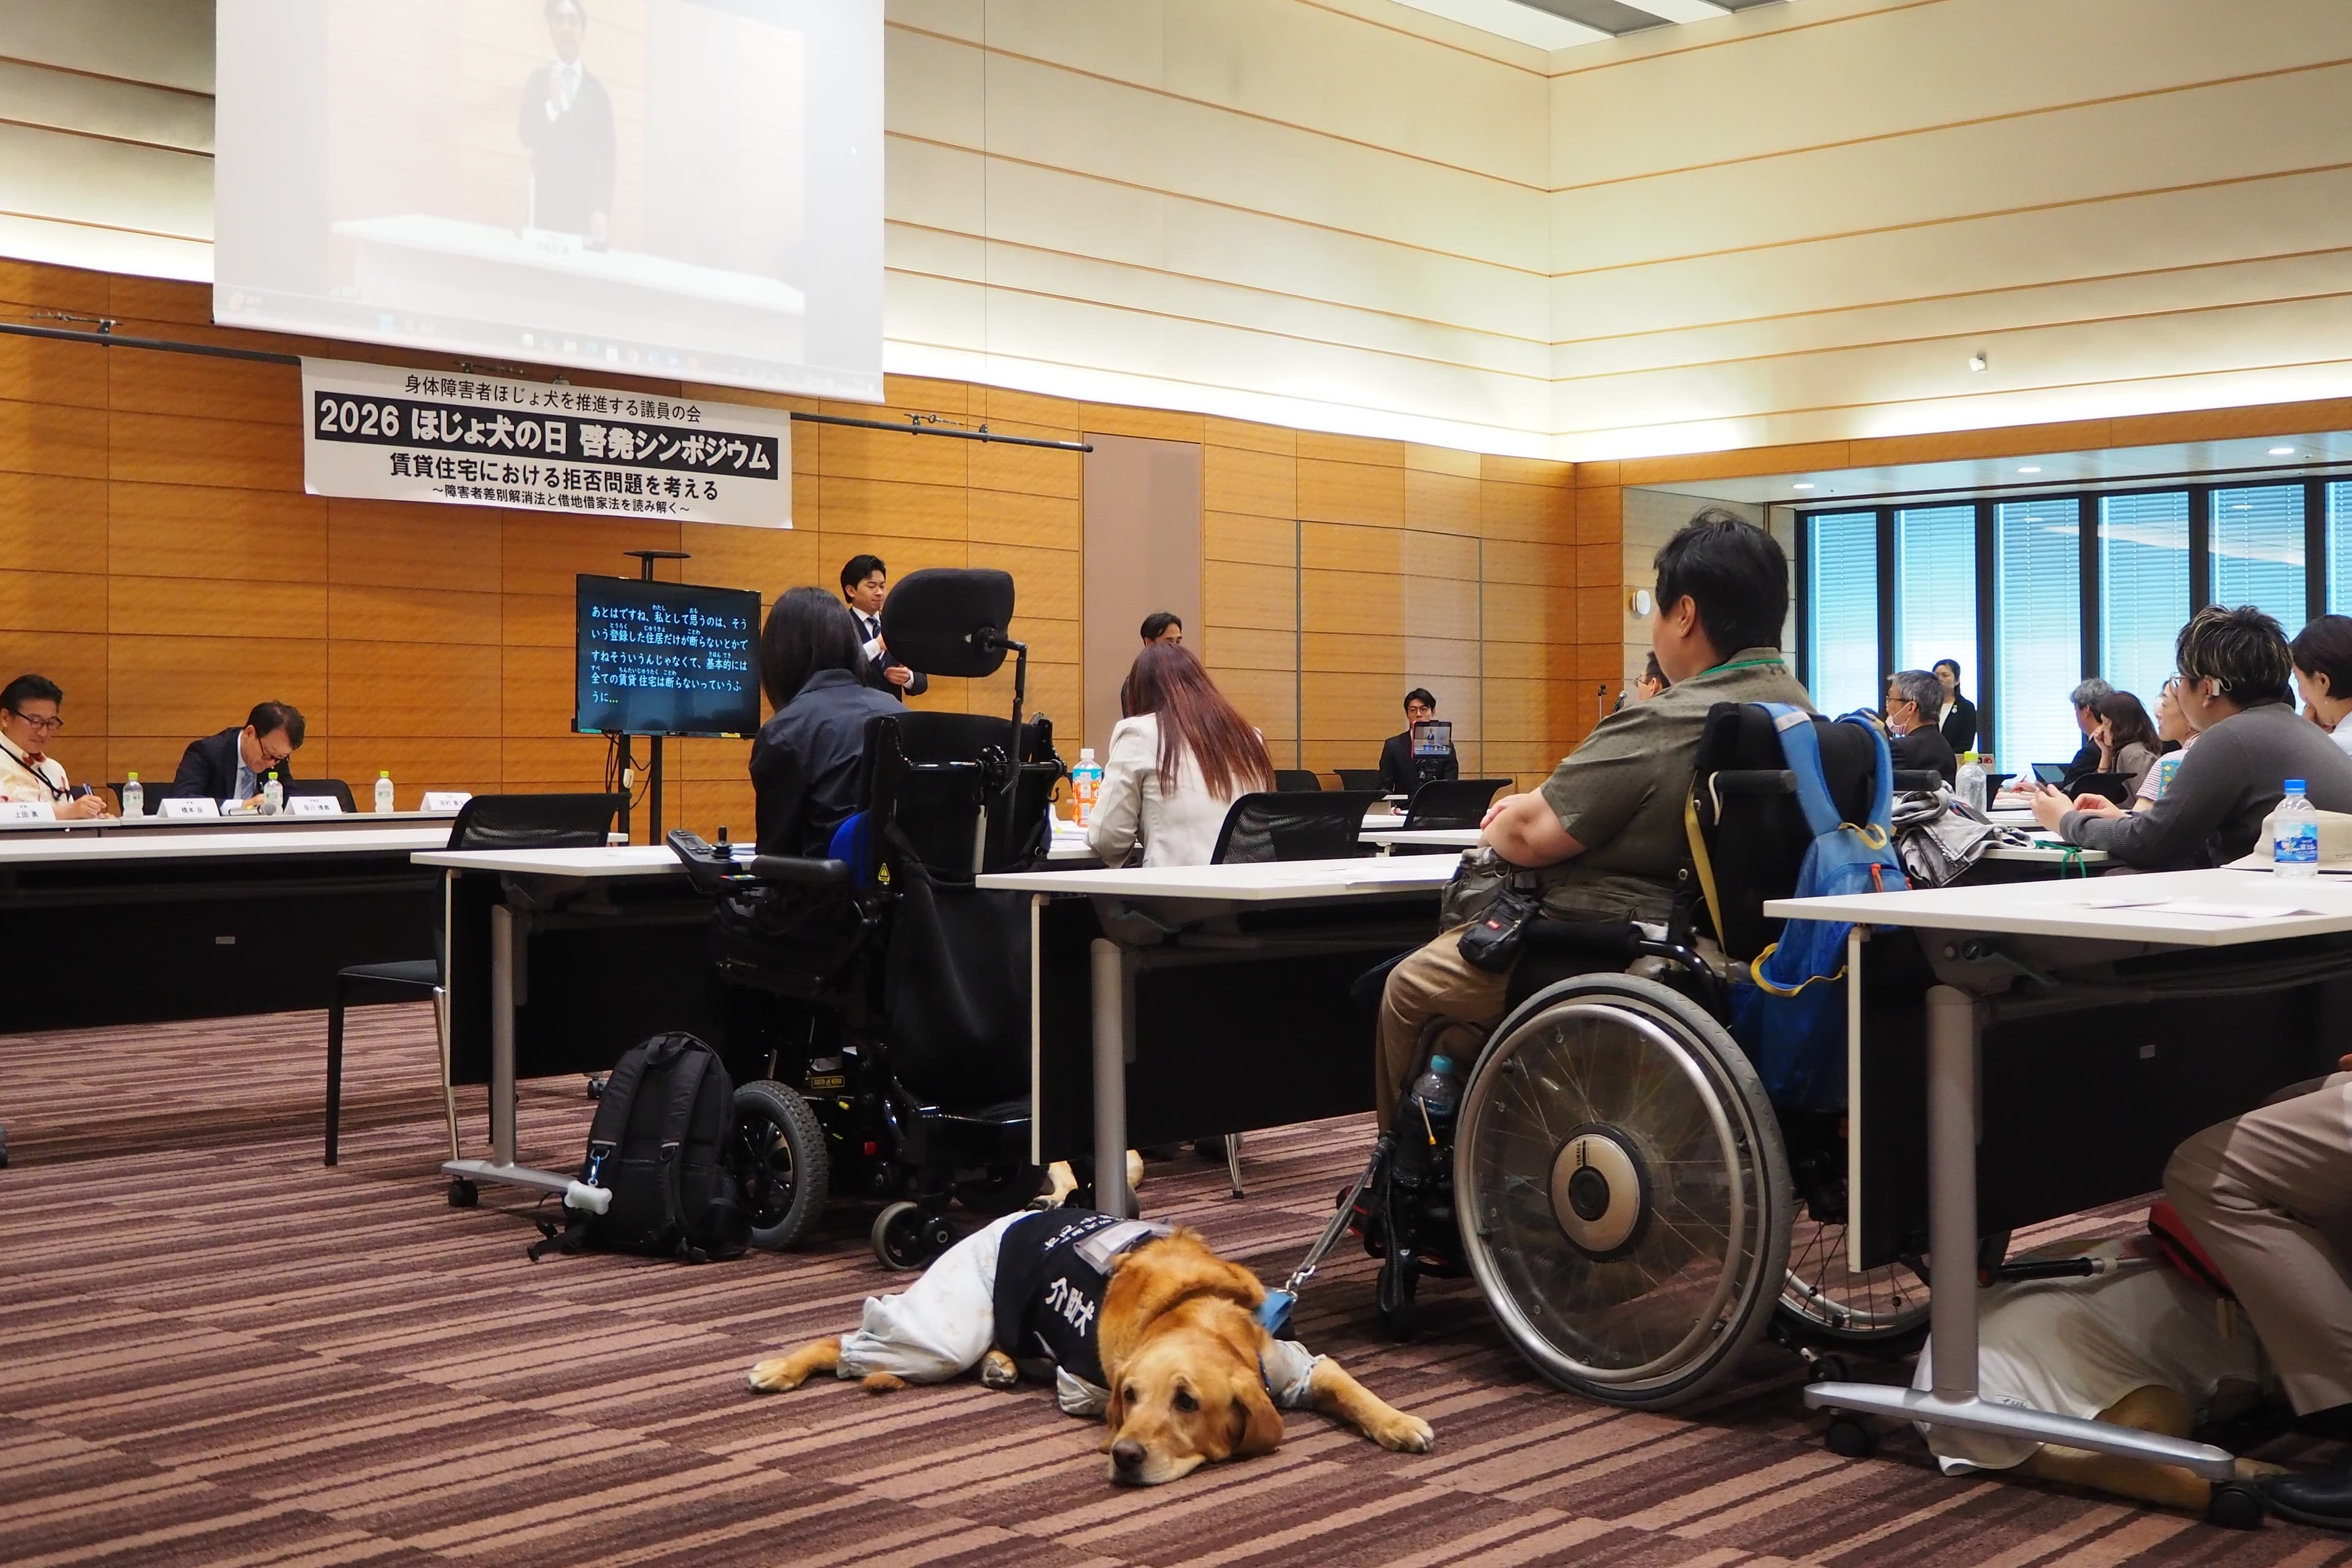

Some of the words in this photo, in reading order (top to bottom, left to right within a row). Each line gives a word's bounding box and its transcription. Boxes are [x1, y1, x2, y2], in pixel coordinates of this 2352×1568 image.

[405, 374, 701, 424] 身体障害者ほじょ犬を推進する議員の会
[320, 399, 399, 437] 2026
[411, 408, 567, 454] ほじょ犬の日
[579, 424, 771, 470] 啓発シンポジウム
[390, 452, 718, 500] 賃貸住宅における拒否問題を考える
[1045, 1276, 1095, 1337] 介助犬
